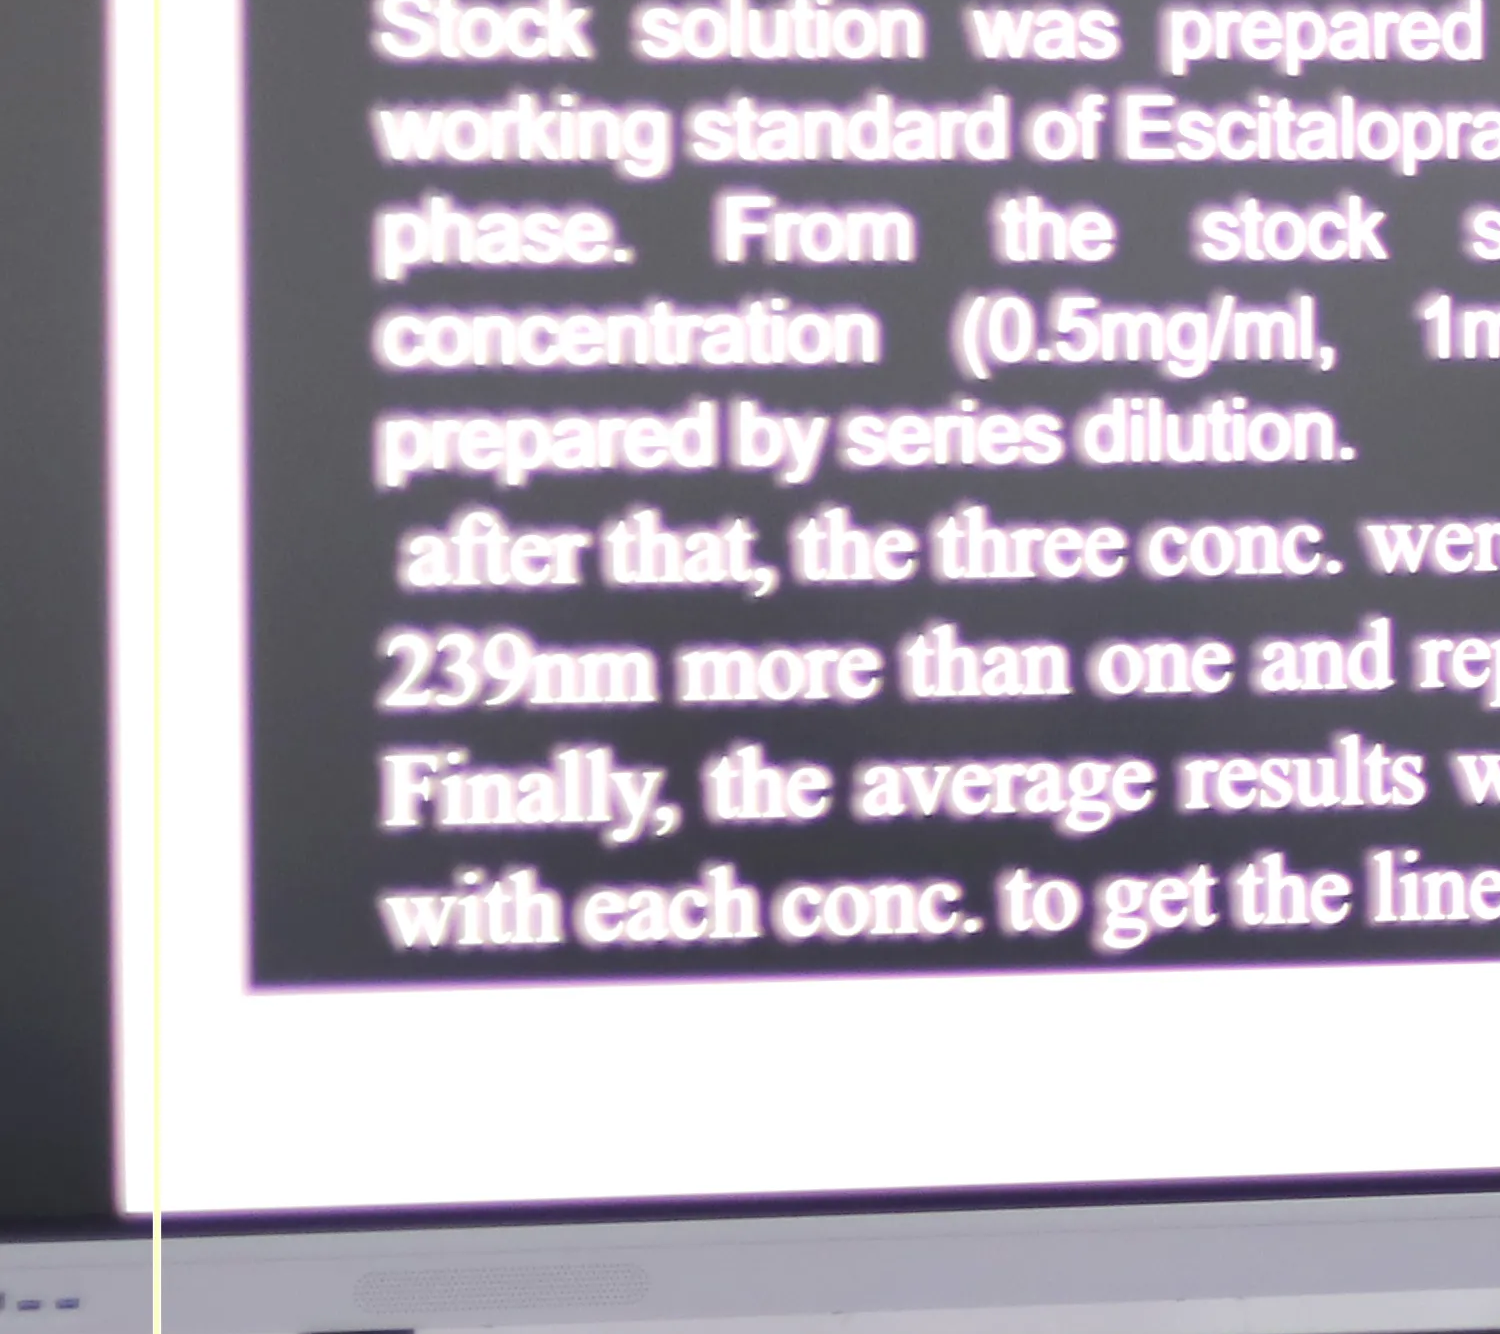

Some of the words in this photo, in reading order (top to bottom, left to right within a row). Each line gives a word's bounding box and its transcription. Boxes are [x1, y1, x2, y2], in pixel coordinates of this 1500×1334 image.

[969, 8, 1119, 59] was
[376, 94, 671, 178] working
[687, 94, 1009, 160] standard
[1026, 93, 1106, 160] of
[376, 197, 631, 279] phase.
[718, 192, 914, 262] From
[995, 196, 1115, 261] the
[1197, 195, 1387, 260] stock
[376, 297, 878, 367] concentration
[956, 295, 1334, 379] (0.5mg/ml,
[377, 401, 717, 486] prepared
[731, 401, 828, 482] by
[842, 399, 1064, 466] series
[1077, 397, 1354, 463] dilution.
[402, 511, 590, 587] after
[603, 509, 776, 596] that,
[794, 507, 917, 581] the
[933, 505, 1126, 578] three
[1142, 524, 1341, 576] conc.
[382, 630, 655, 707] 239nm
[679, 647, 881, 701] more
[903, 623, 1069, 697] than
[1092, 642, 1232, 694] one
[1256, 617, 1393, 691] and
[384, 747, 678, 841] Finally,
[706, 745, 830, 819] the
[859, 760, 1153, 832] average
[1182, 734, 1425, 808] results
[384, 870, 559, 945] with
[579, 865, 758, 942] each
[777, 882, 980, 937] conc.
[1001, 869, 1079, 930] to
[1098, 865, 1215, 948] get
[1234, 852, 1350, 924] the
